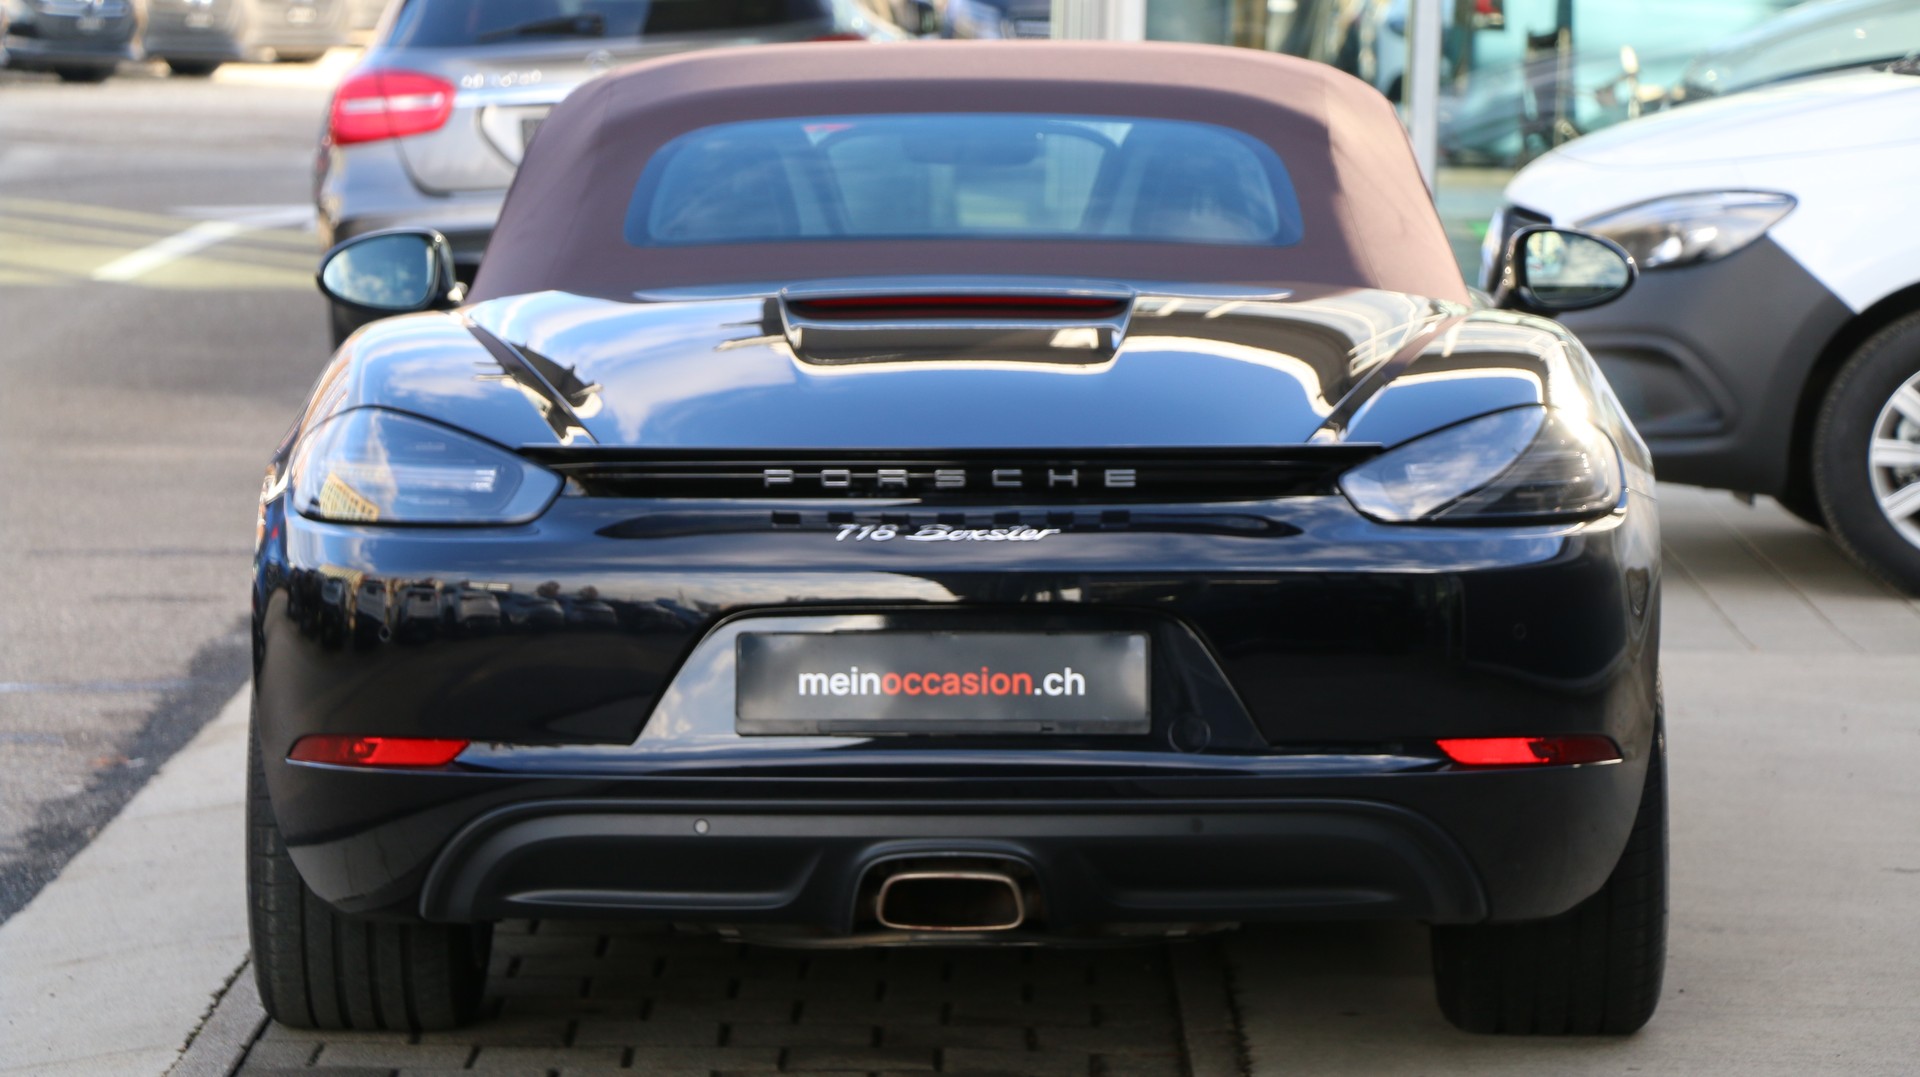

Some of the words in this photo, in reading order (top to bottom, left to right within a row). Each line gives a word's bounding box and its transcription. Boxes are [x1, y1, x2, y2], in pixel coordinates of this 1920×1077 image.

[764, 468, 1137, 487] PORSCHE
[835, 523, 898, 542] 718
[905, 523, 1061, 542] Boxster
[799, 666, 1086, 696] meinoccasion.ch
